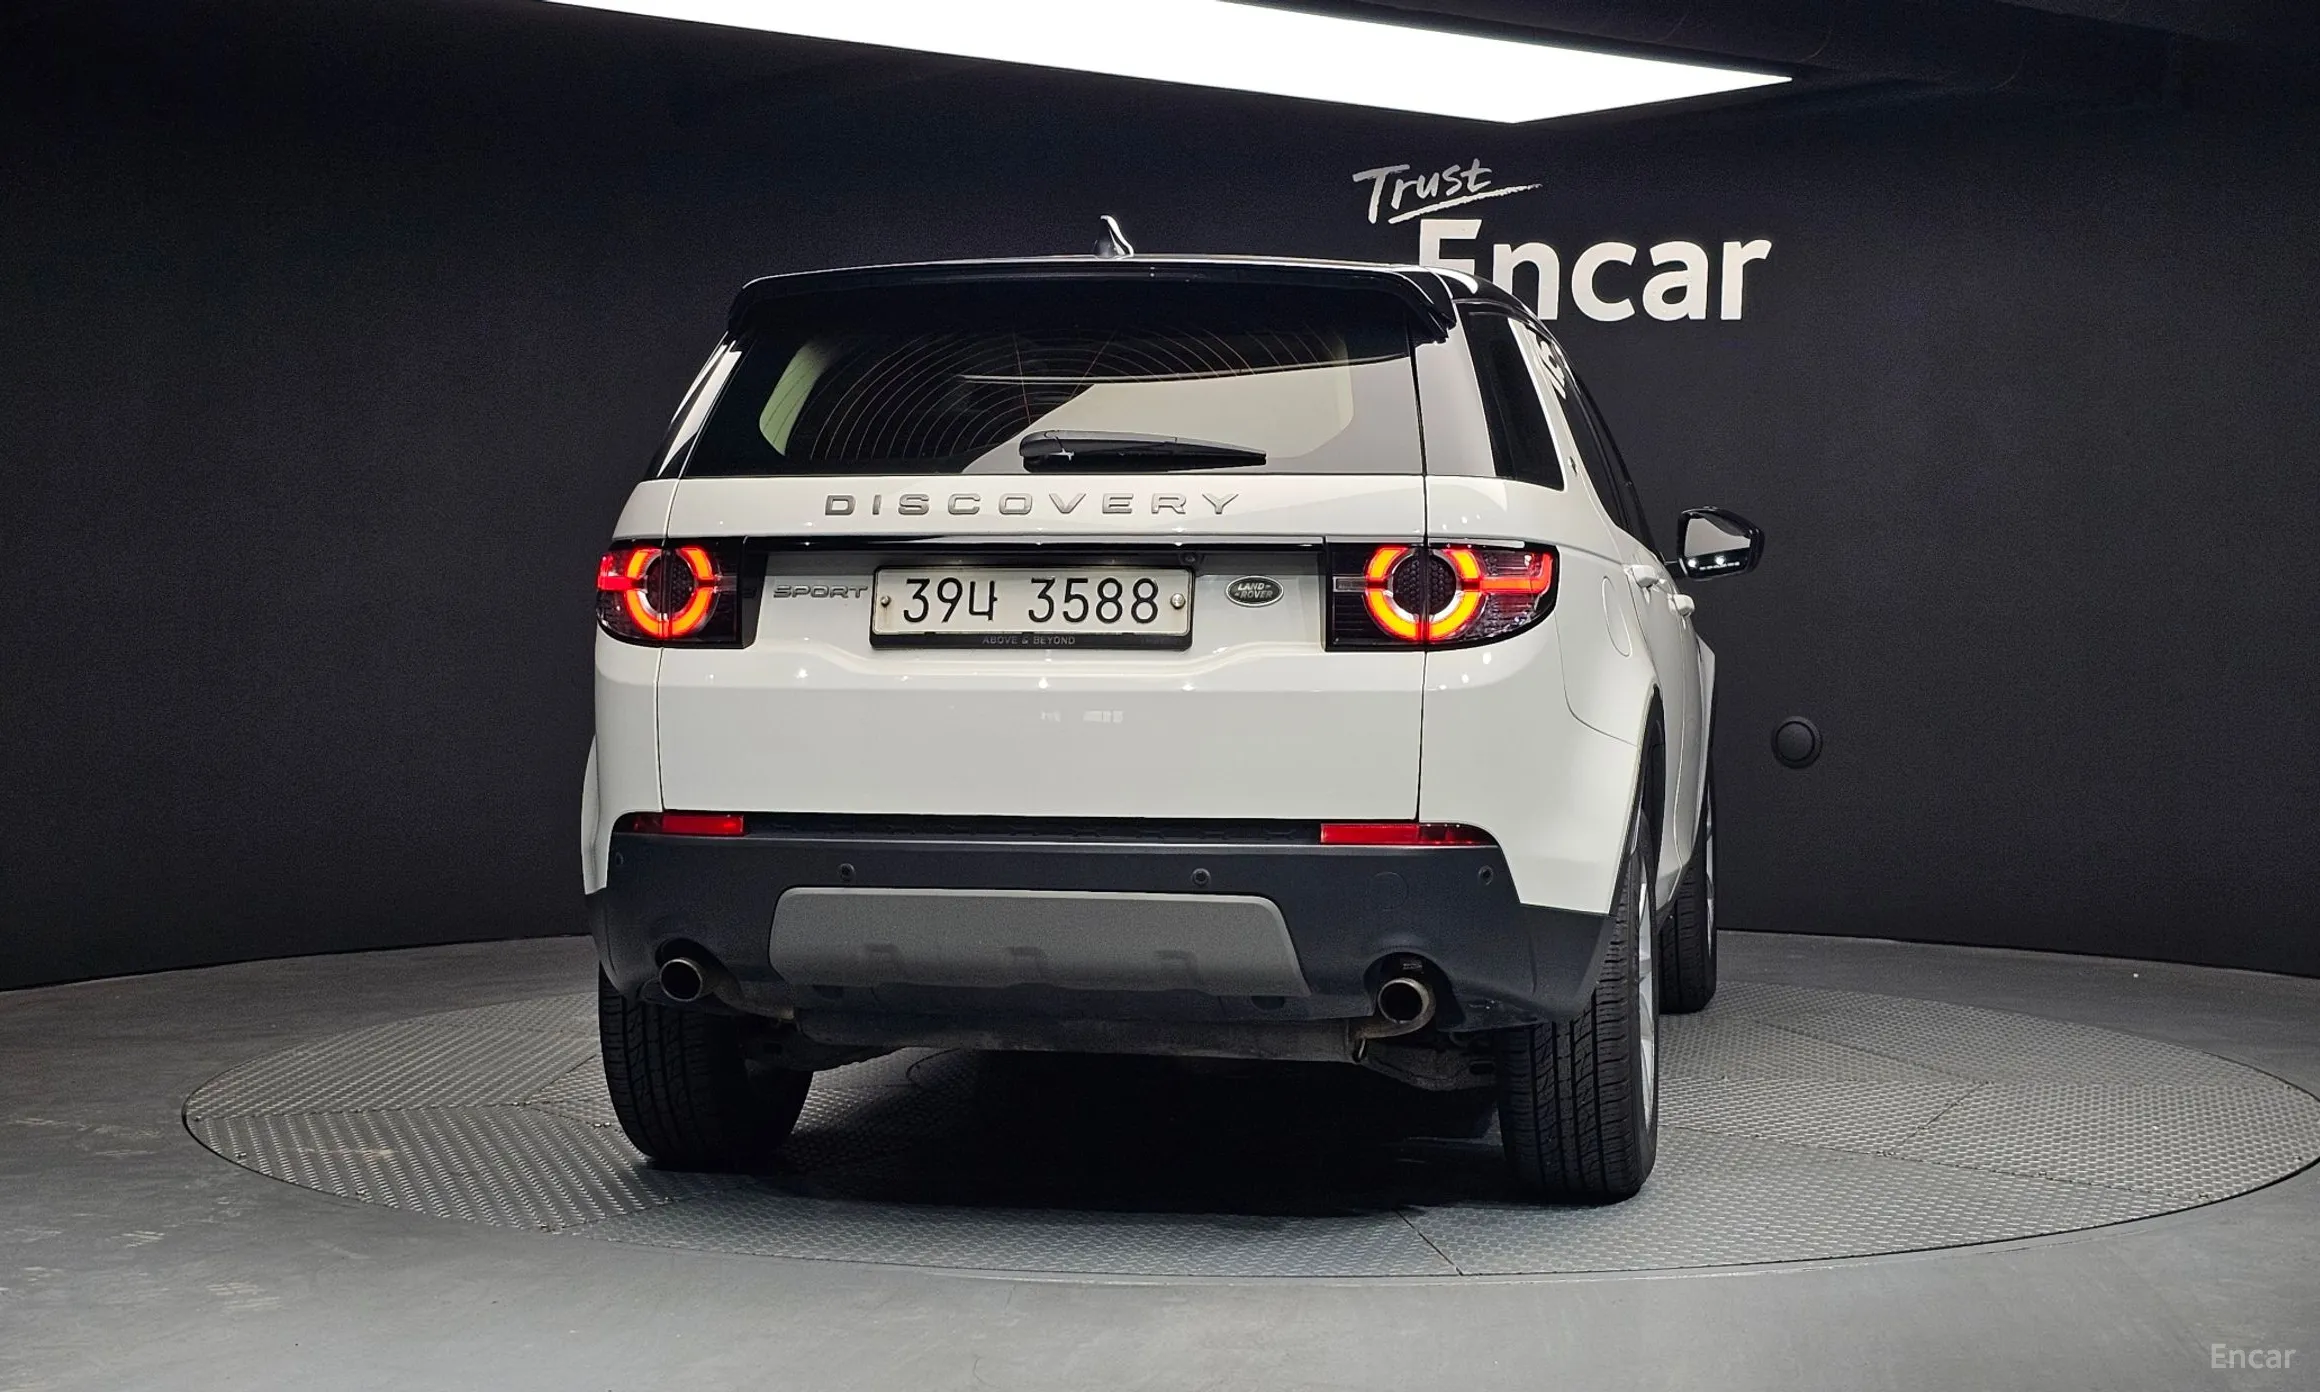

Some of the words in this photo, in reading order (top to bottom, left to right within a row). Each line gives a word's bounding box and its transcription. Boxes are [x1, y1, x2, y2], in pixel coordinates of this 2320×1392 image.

[1353, 158, 1492, 223] Trust
[824, 493, 1240, 516] DISCOVERY
[773, 584, 869, 599] SPORT
[903, 577, 998, 623] 39나
[1028, 577, 1159, 624] 3588
[982, 636, 1018, 645] ABOVE
[1021, 636, 1029, 645] &
[1033, 636, 1076, 646] BEYOND
